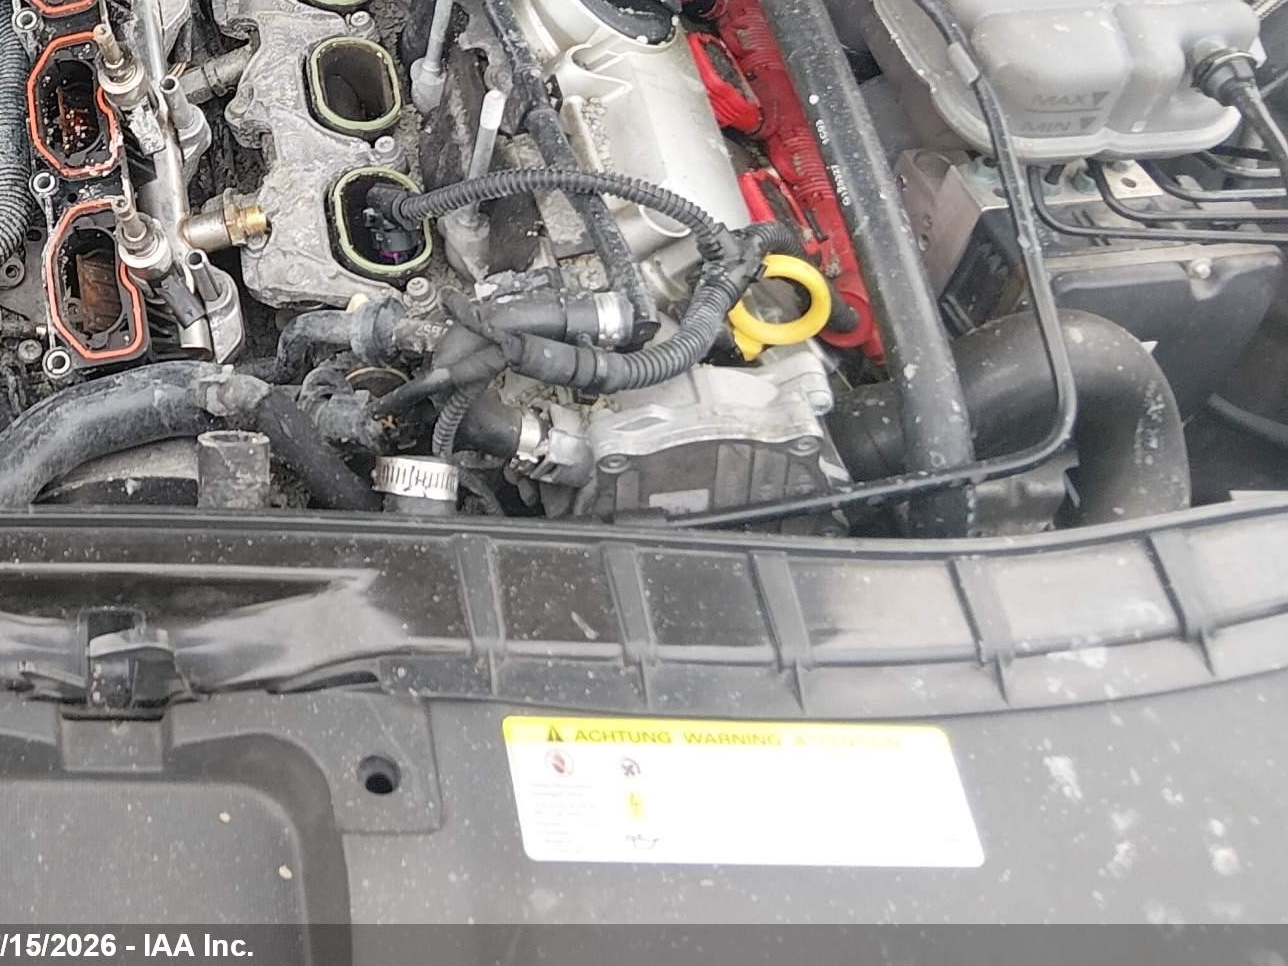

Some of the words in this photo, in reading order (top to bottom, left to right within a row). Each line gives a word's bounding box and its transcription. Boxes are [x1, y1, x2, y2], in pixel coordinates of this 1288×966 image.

[1031, 93, 1091, 108] MAX
[1015, 120, 1072, 132] MIN
[574, 728, 673, 746] ACHTUNG
[682, 731, 782, 748] WARNING
